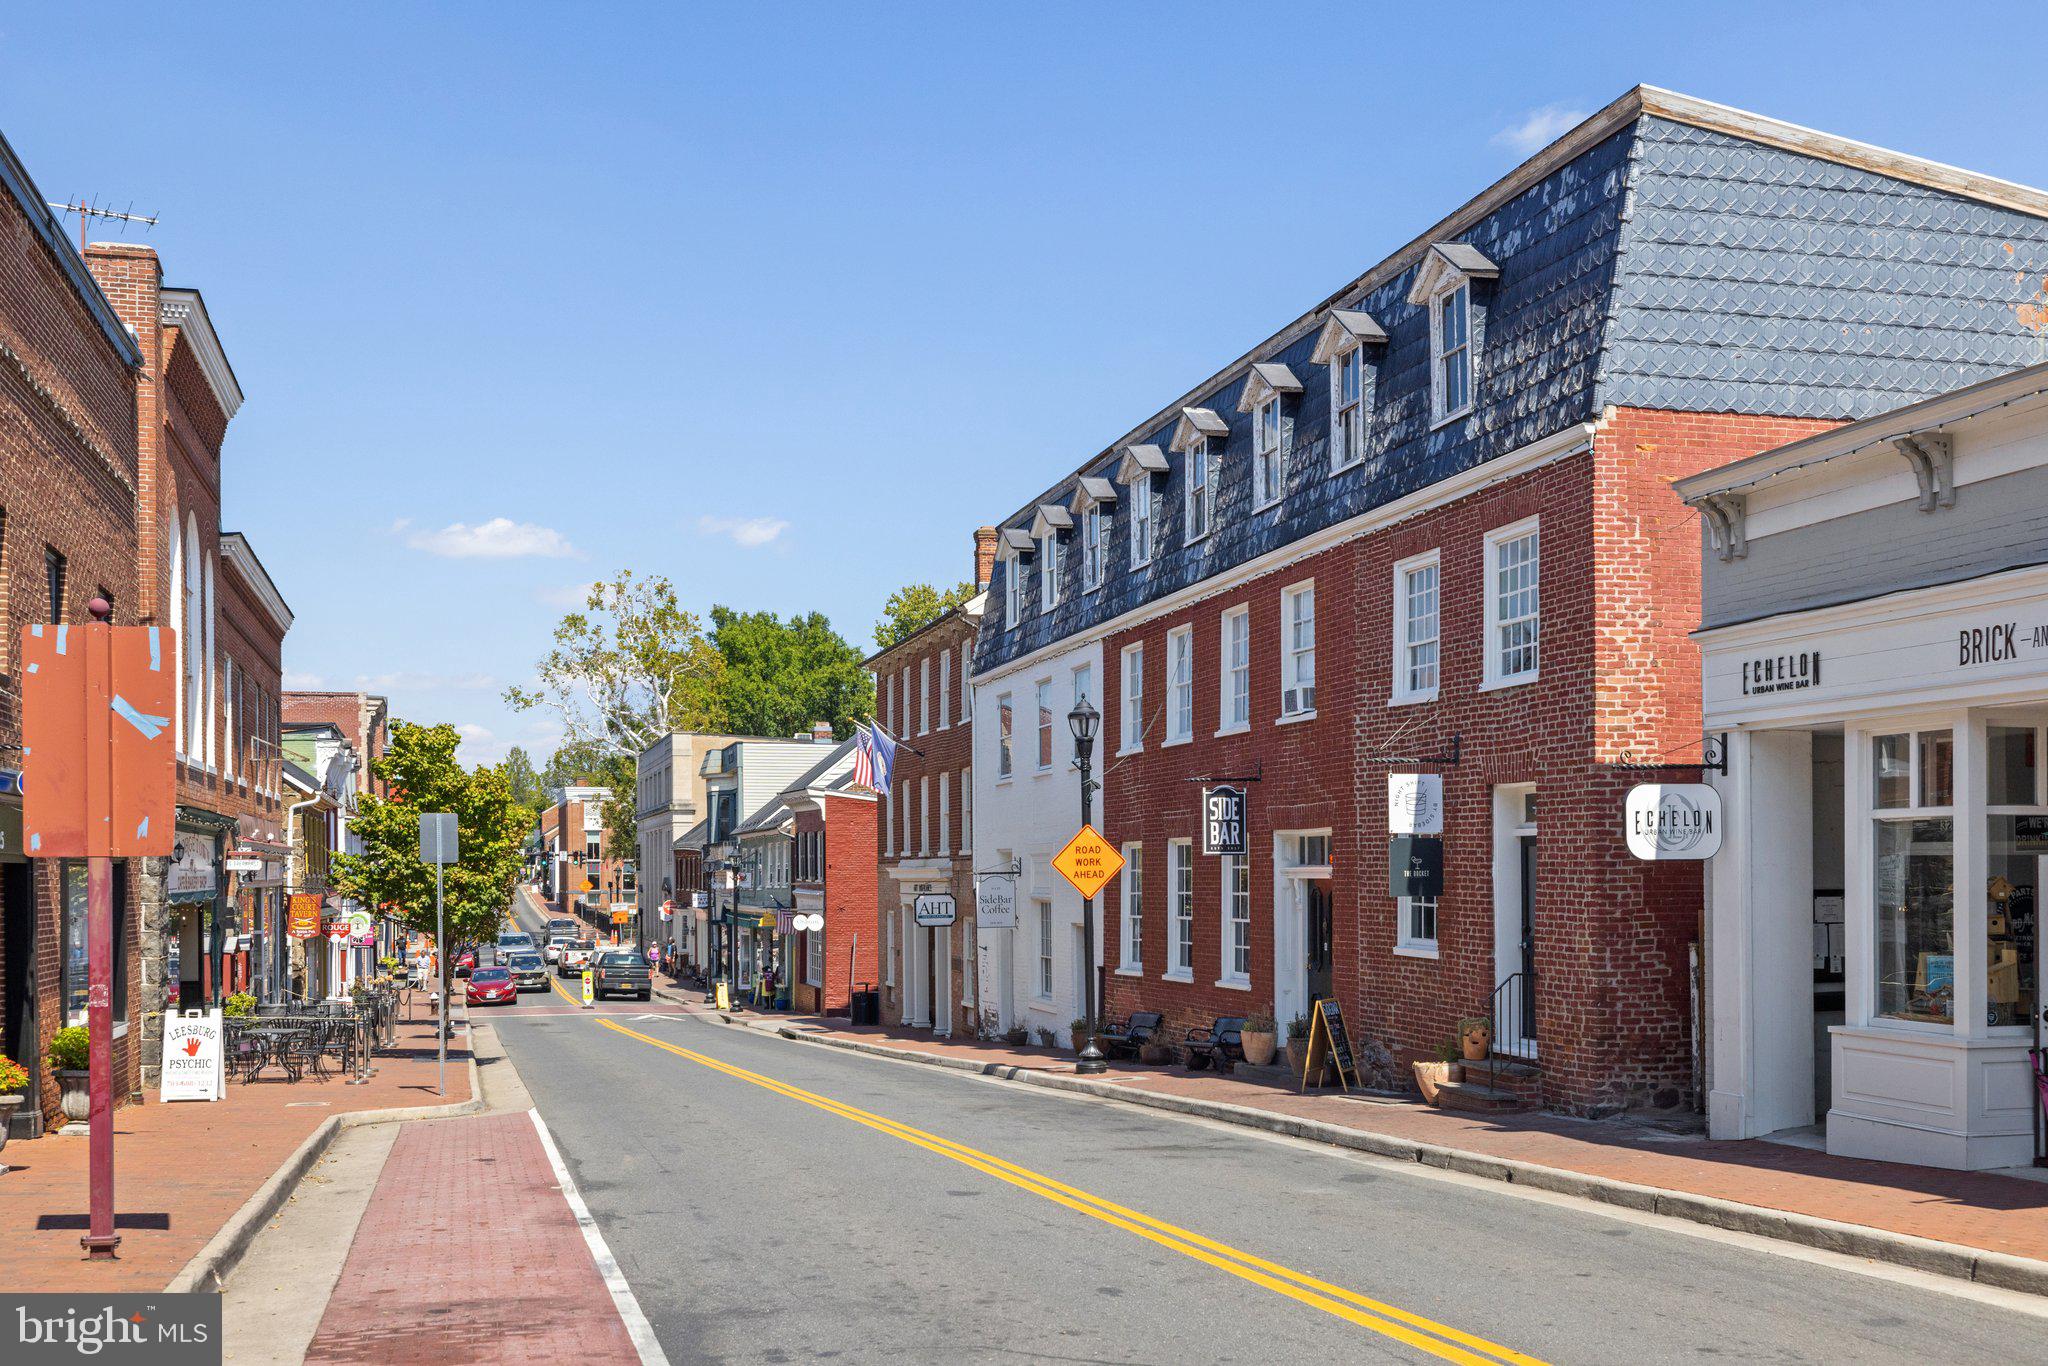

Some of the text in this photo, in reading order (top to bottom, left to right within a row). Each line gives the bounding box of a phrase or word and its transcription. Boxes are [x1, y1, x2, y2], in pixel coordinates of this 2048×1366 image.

[1959, 622, 2017, 666] BRICK
[1743, 651, 1820, 695] ECHELON
[1752, 679, 1809, 694] URBAN WINE BAR
[1209, 797, 1240, 820] SIDE
[1635, 810, 1712, 835] ECHELON
[1209, 821, 1240, 845] BAR
[1075, 846, 1101, 854] ROAD
[1075, 858, 1102, 866] WORK
[1073, 870, 1105, 879] AHEAD
[979, 894, 1012, 904] SideBar
[919, 902, 952, 915] AHT
[981, 904, 1010, 914] Coffee
[322, 923, 349, 931] ROUGE
[168, 1024, 217, 1041] LEESBURG
[169, 1058, 212, 1069] PSYCHIC
